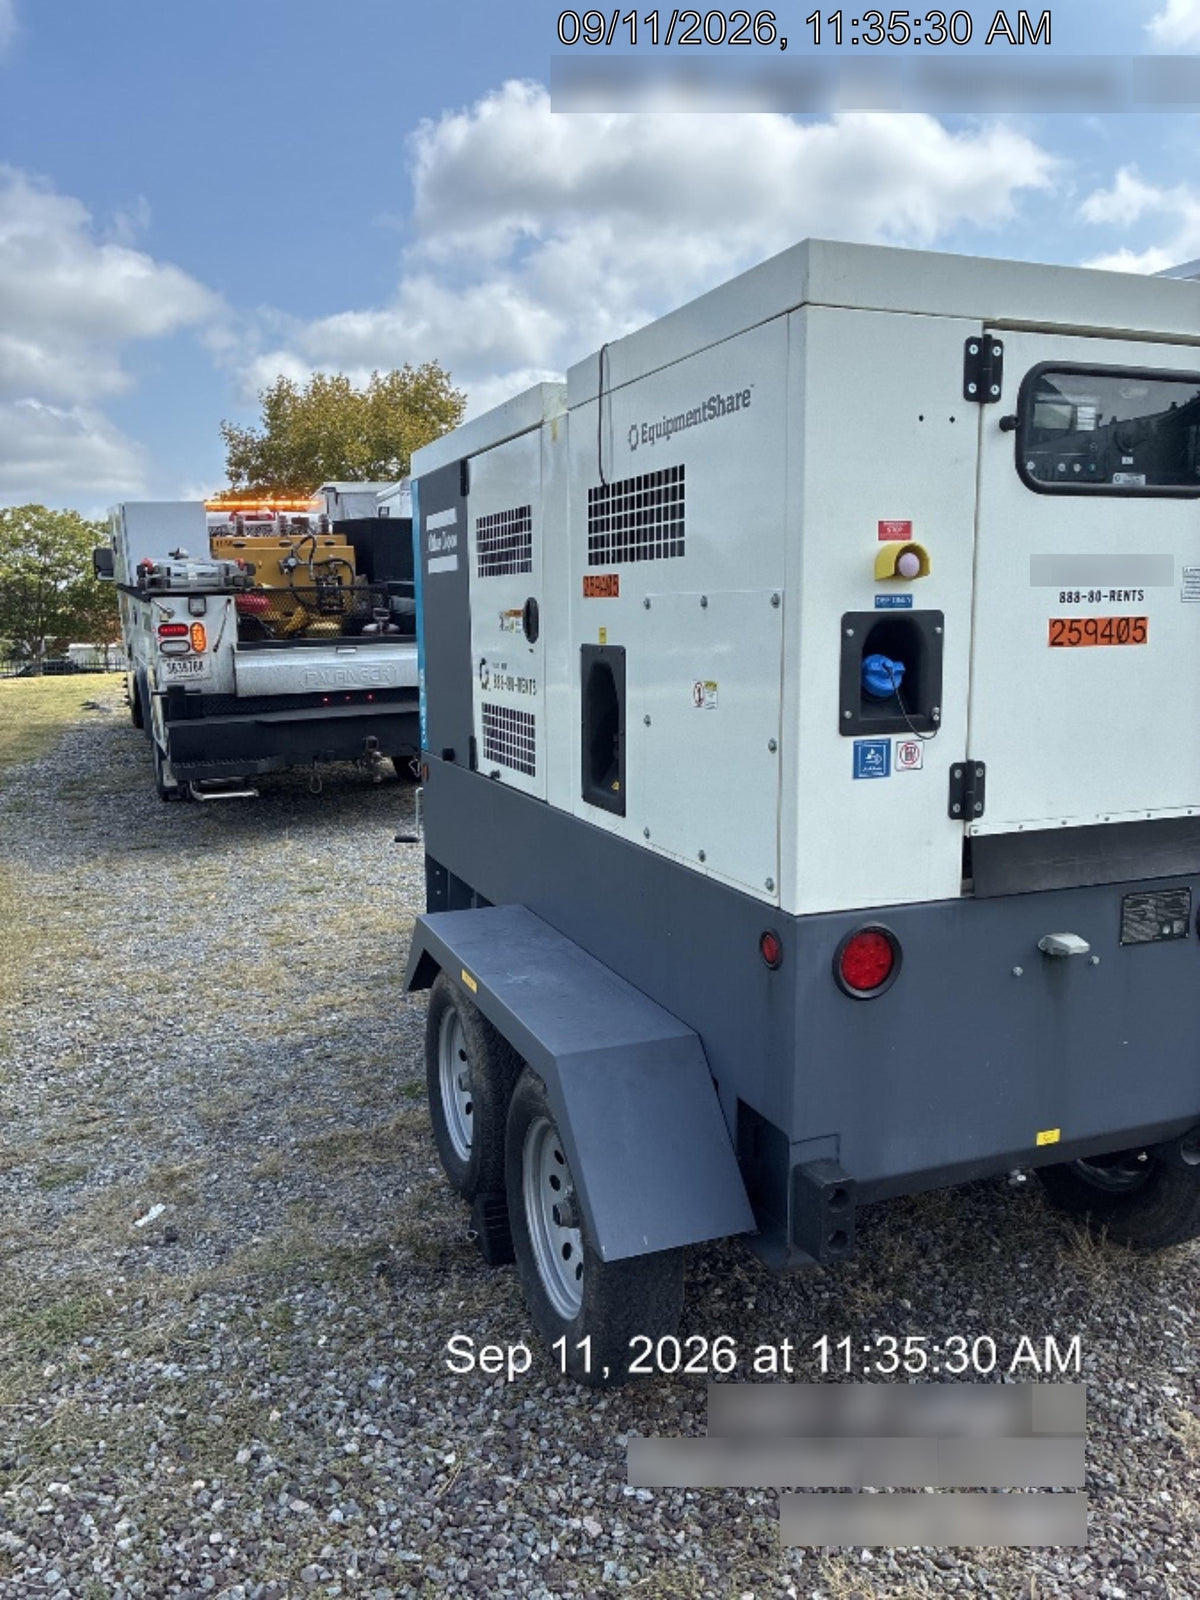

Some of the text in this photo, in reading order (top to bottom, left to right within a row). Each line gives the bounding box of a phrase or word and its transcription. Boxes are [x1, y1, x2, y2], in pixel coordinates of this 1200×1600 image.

[641, 388, 752, 445] EquipmentShare
[1059, 589, 1145, 604] 888-80-RENTS
[1050, 617, 1147, 647] 259405
